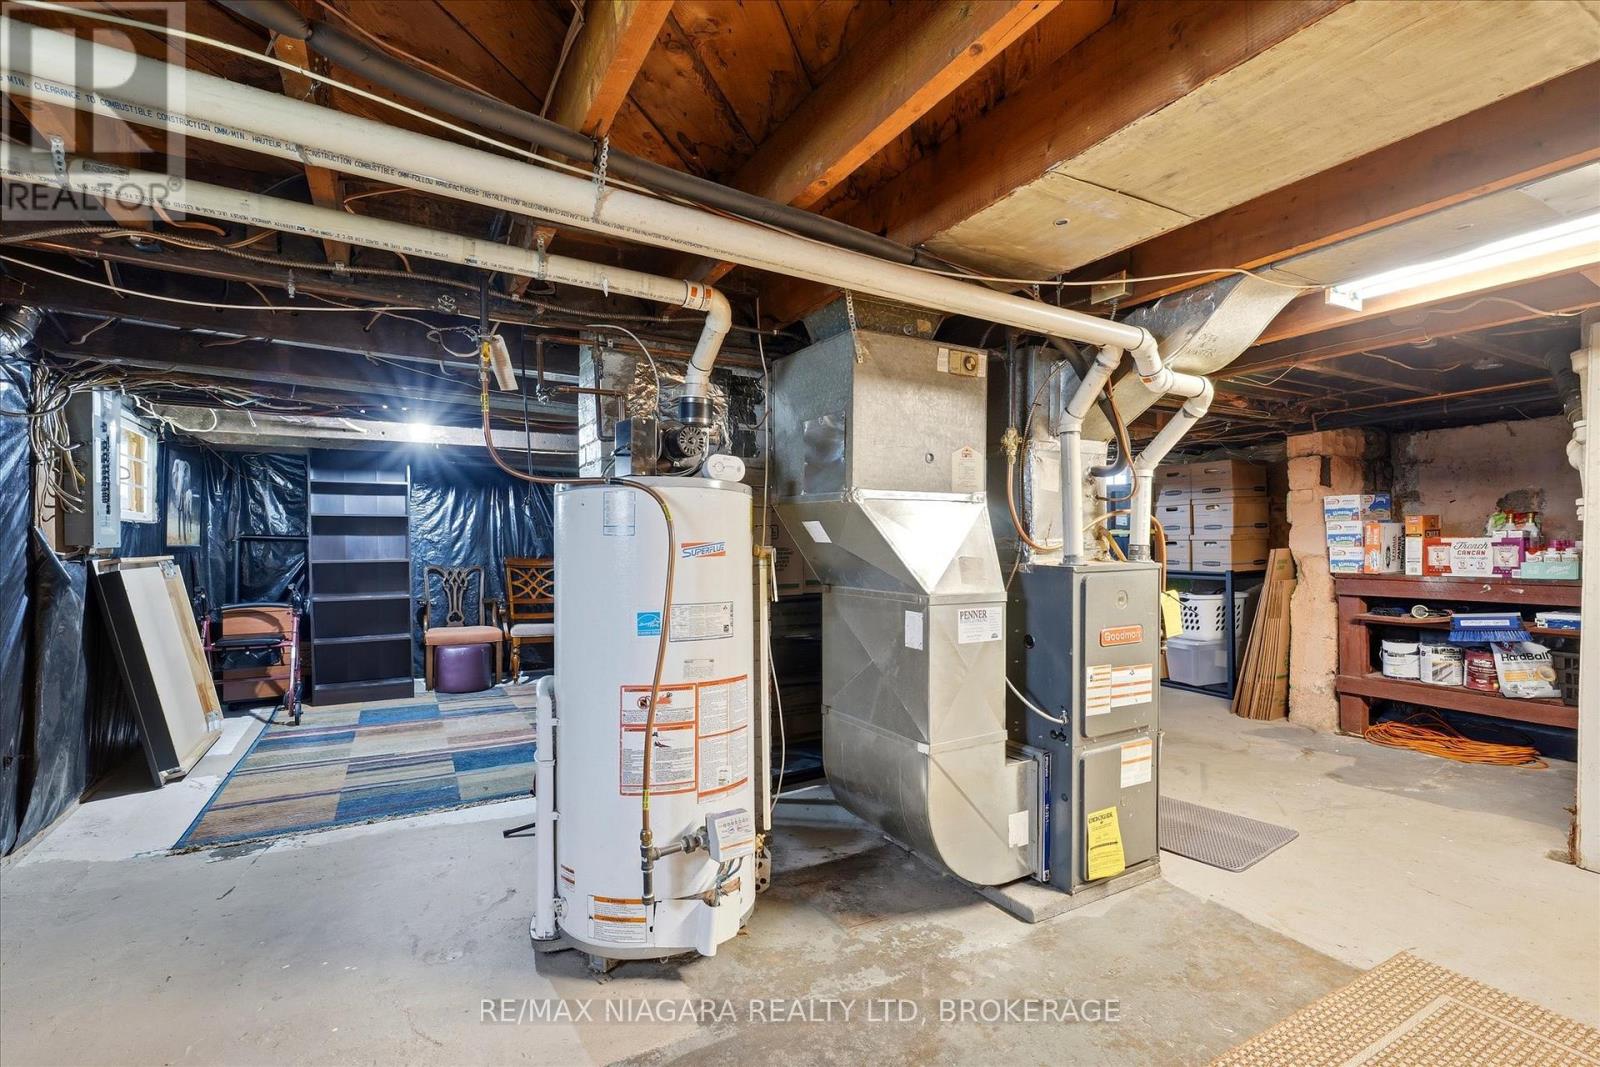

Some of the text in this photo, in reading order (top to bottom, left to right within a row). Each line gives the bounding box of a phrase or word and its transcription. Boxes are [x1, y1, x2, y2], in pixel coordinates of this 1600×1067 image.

[100, 98, 153, 118] COMBUSTIBLE
[156, 111, 211, 132] CONSTRUCTION
[1104, 631, 1142, 641] Goodman
